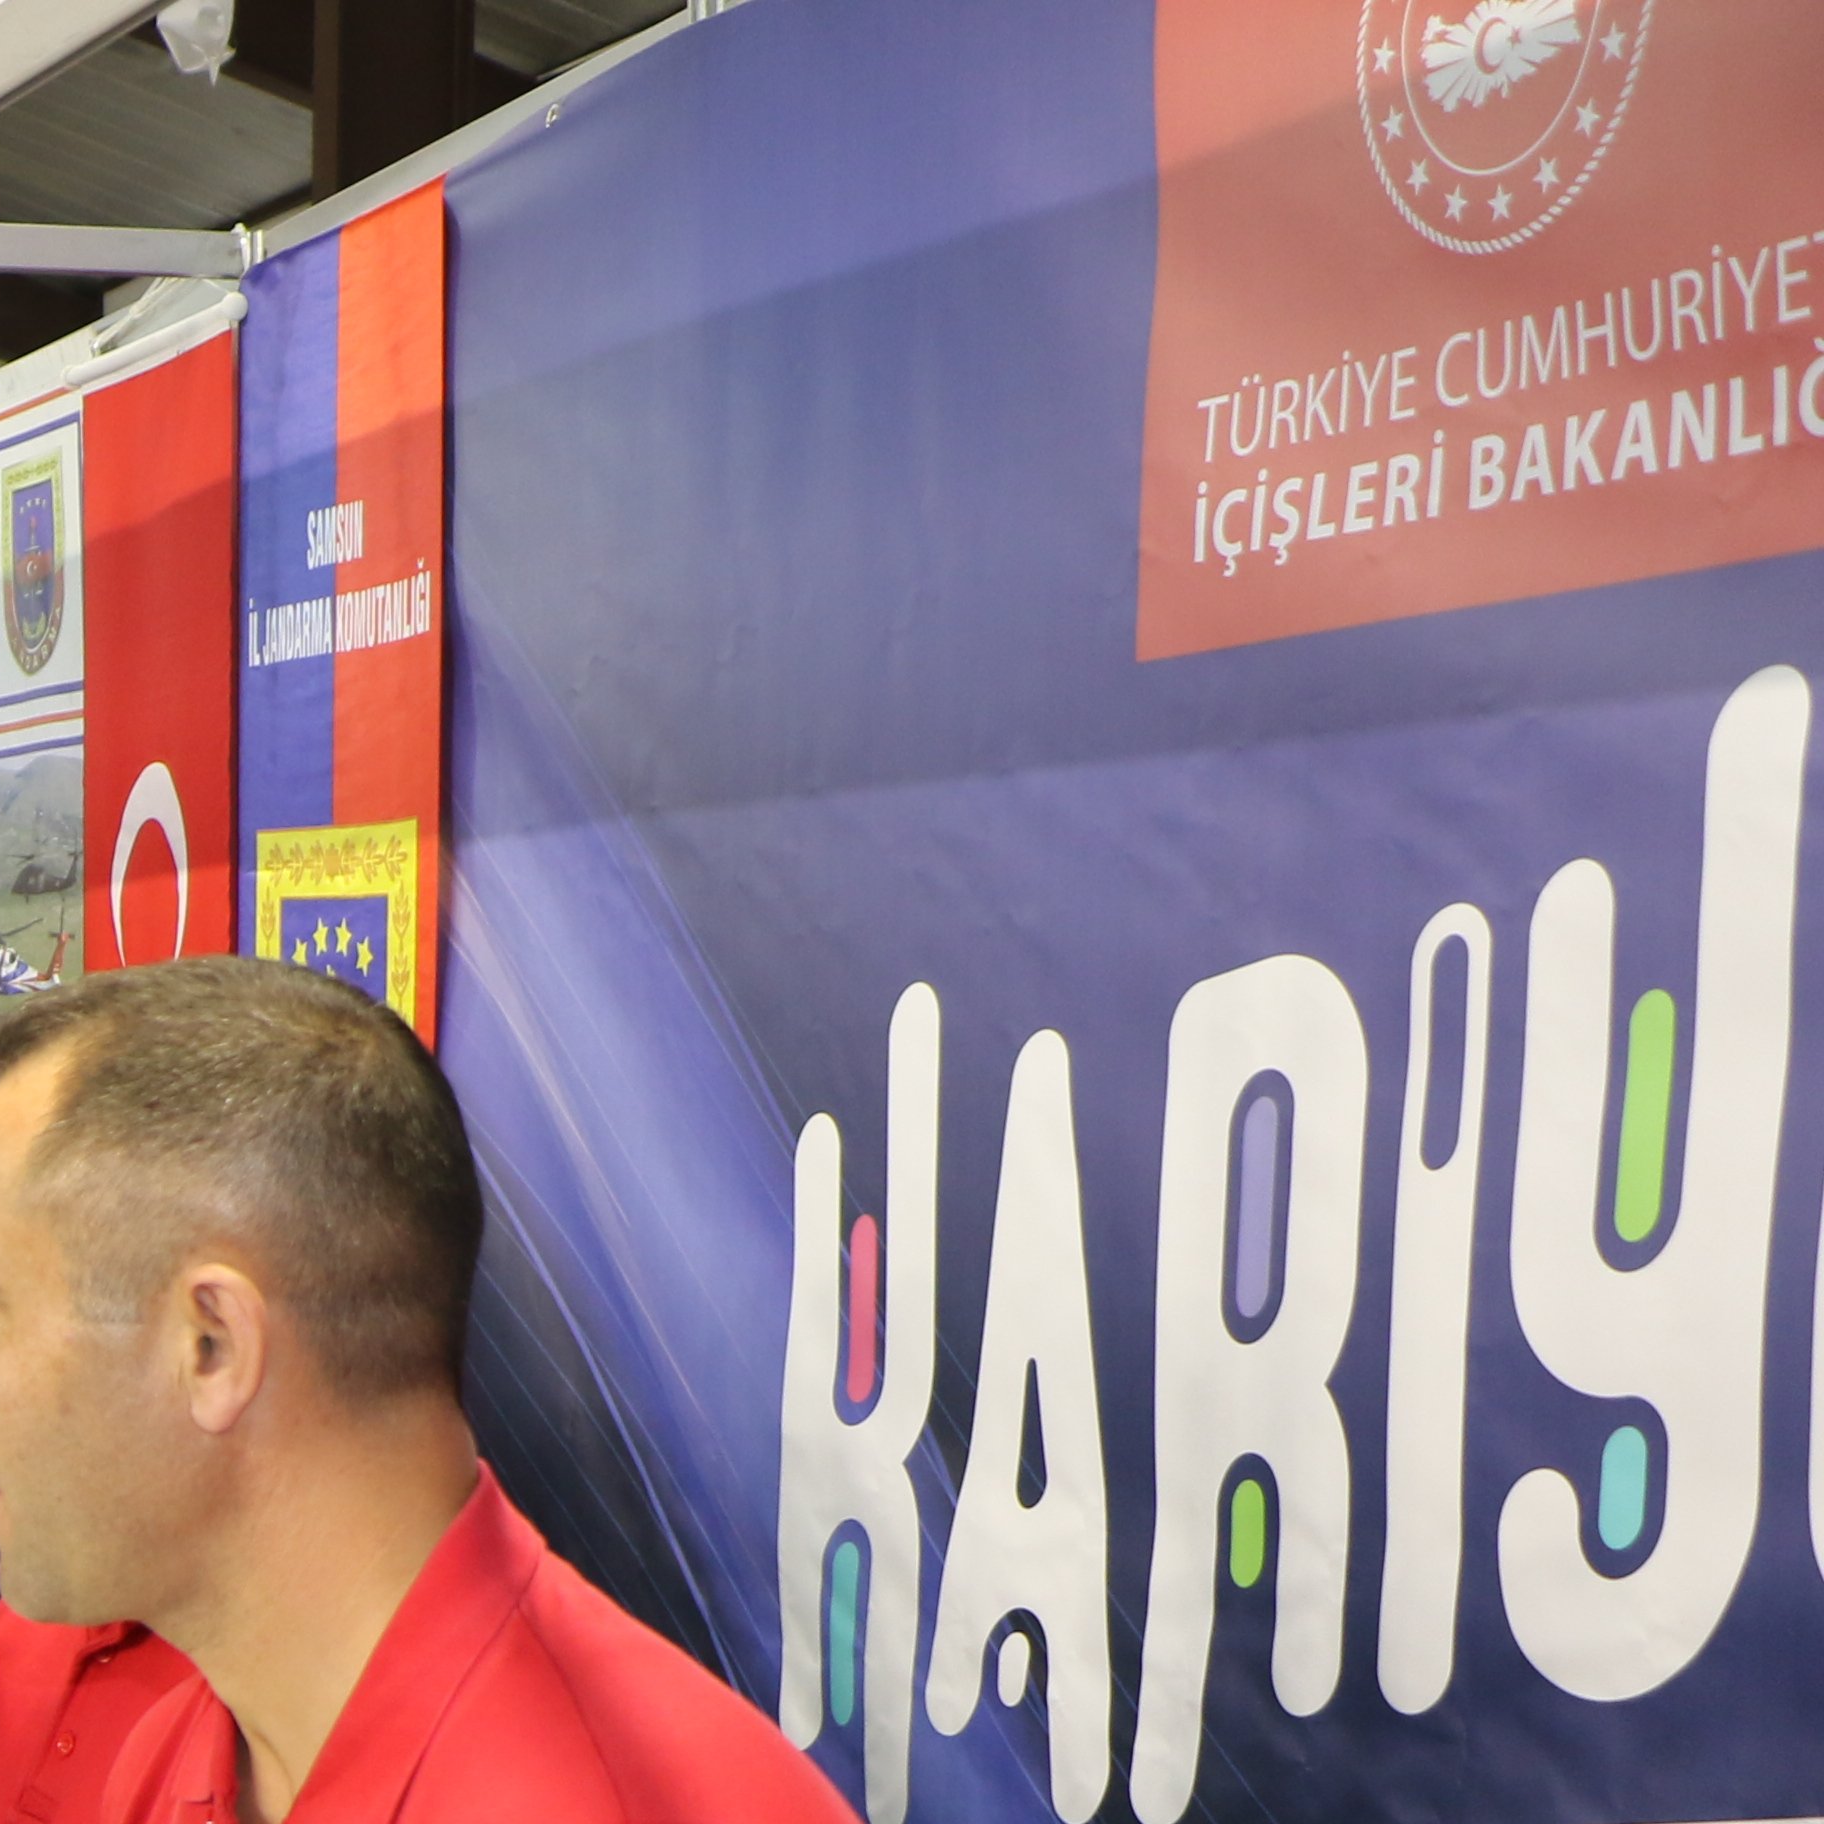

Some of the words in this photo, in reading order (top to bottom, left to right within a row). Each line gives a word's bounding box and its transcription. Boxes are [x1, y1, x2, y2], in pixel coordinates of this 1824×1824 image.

[1196, 346, 1418, 464] TÜRKİYE
[306, 499, 364, 571] SAMSUN
[1193, 428, 1446, 578] İÇİŞLERİ
[248, 598, 261, 668] İL
[262, 596, 333, 667] JANDARMA
[335, 556, 432, 653] KOMUTANLIĞI
